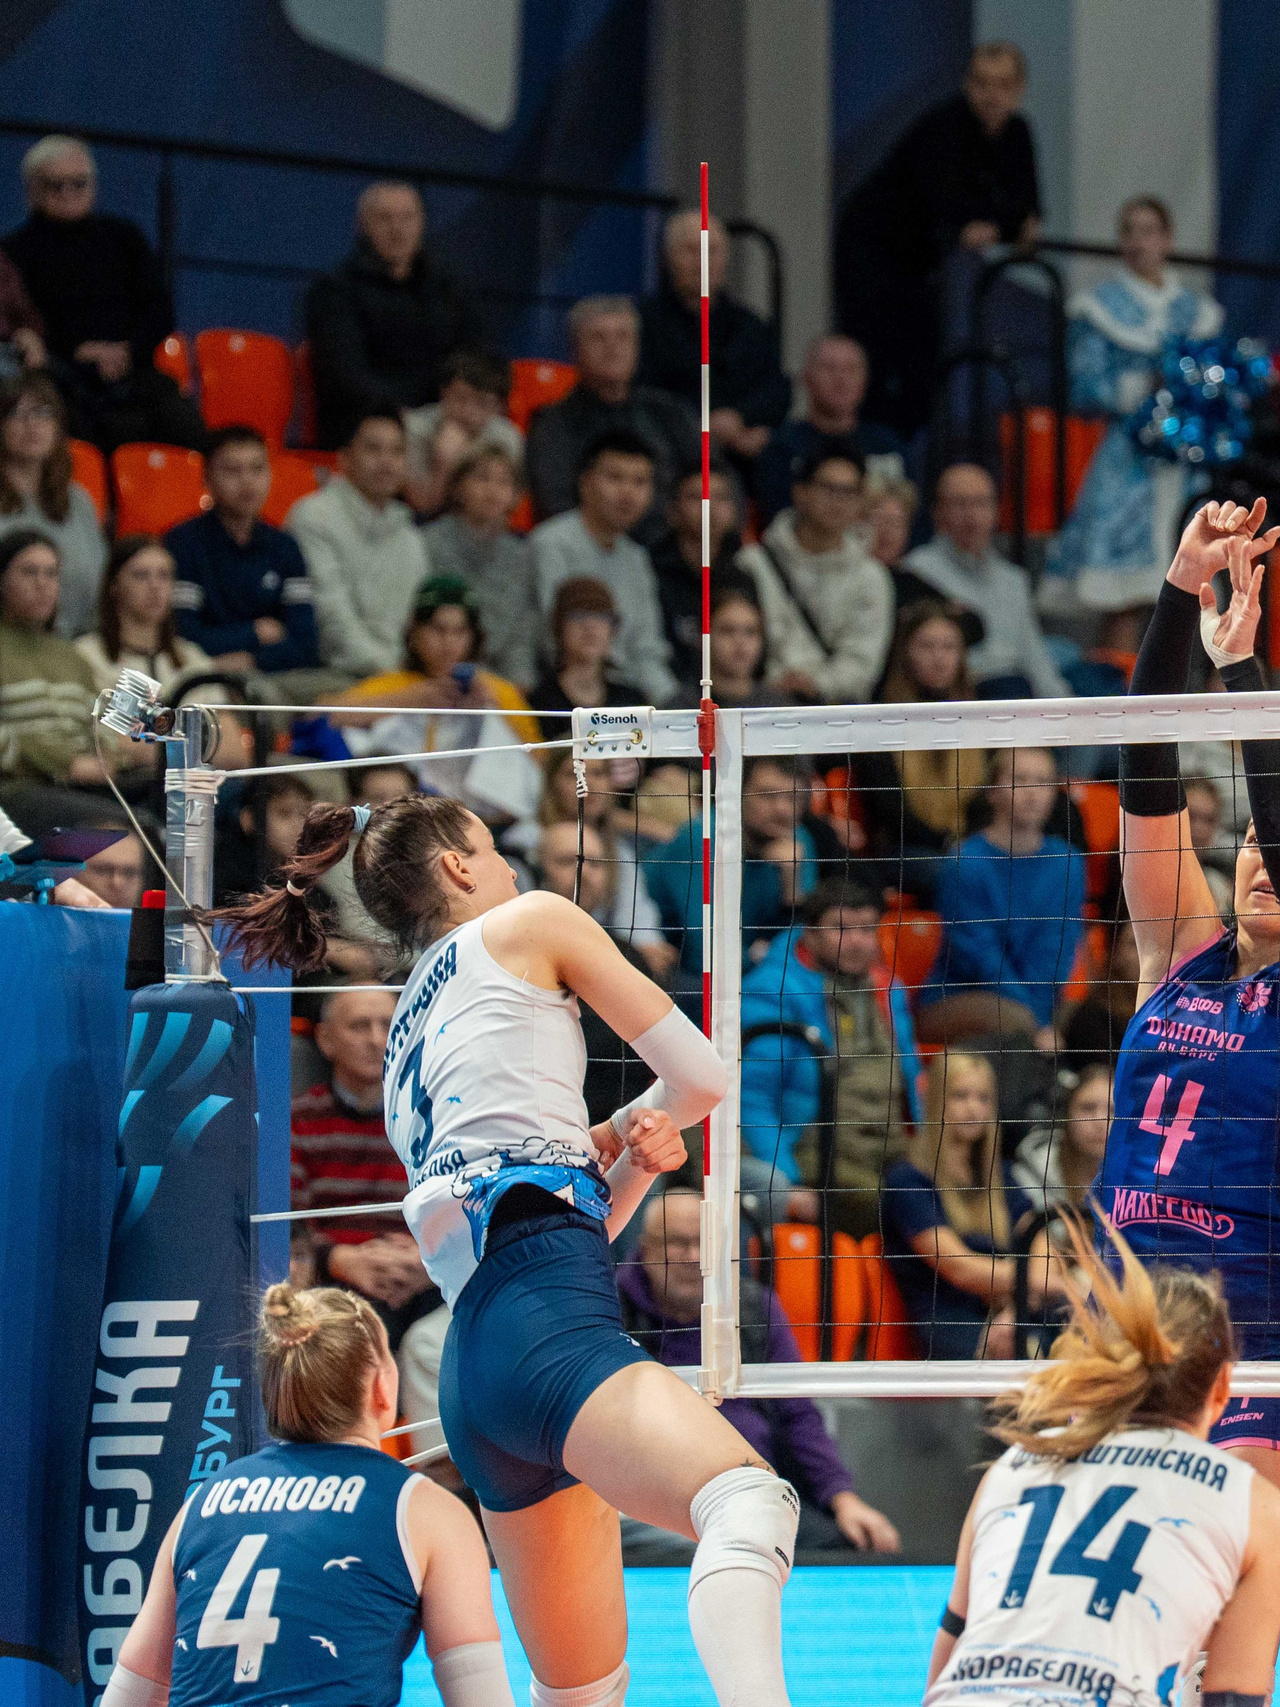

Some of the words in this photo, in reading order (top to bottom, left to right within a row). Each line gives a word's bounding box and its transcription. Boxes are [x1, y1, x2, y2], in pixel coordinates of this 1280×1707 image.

[601, 713, 638, 725] Senoh
[1146, 1016, 1246, 1052] ДИНАМО
[1187, 996, 1224, 1015] ВФВ
[1138, 1073, 1205, 1176] 4
[84, 1300, 200, 1707] АБЕЛКА
[201, 1475, 367, 1518] ИСАКОВА
[998, 1484, 1152, 1622] 14
[196, 1533, 281, 1684] 4
